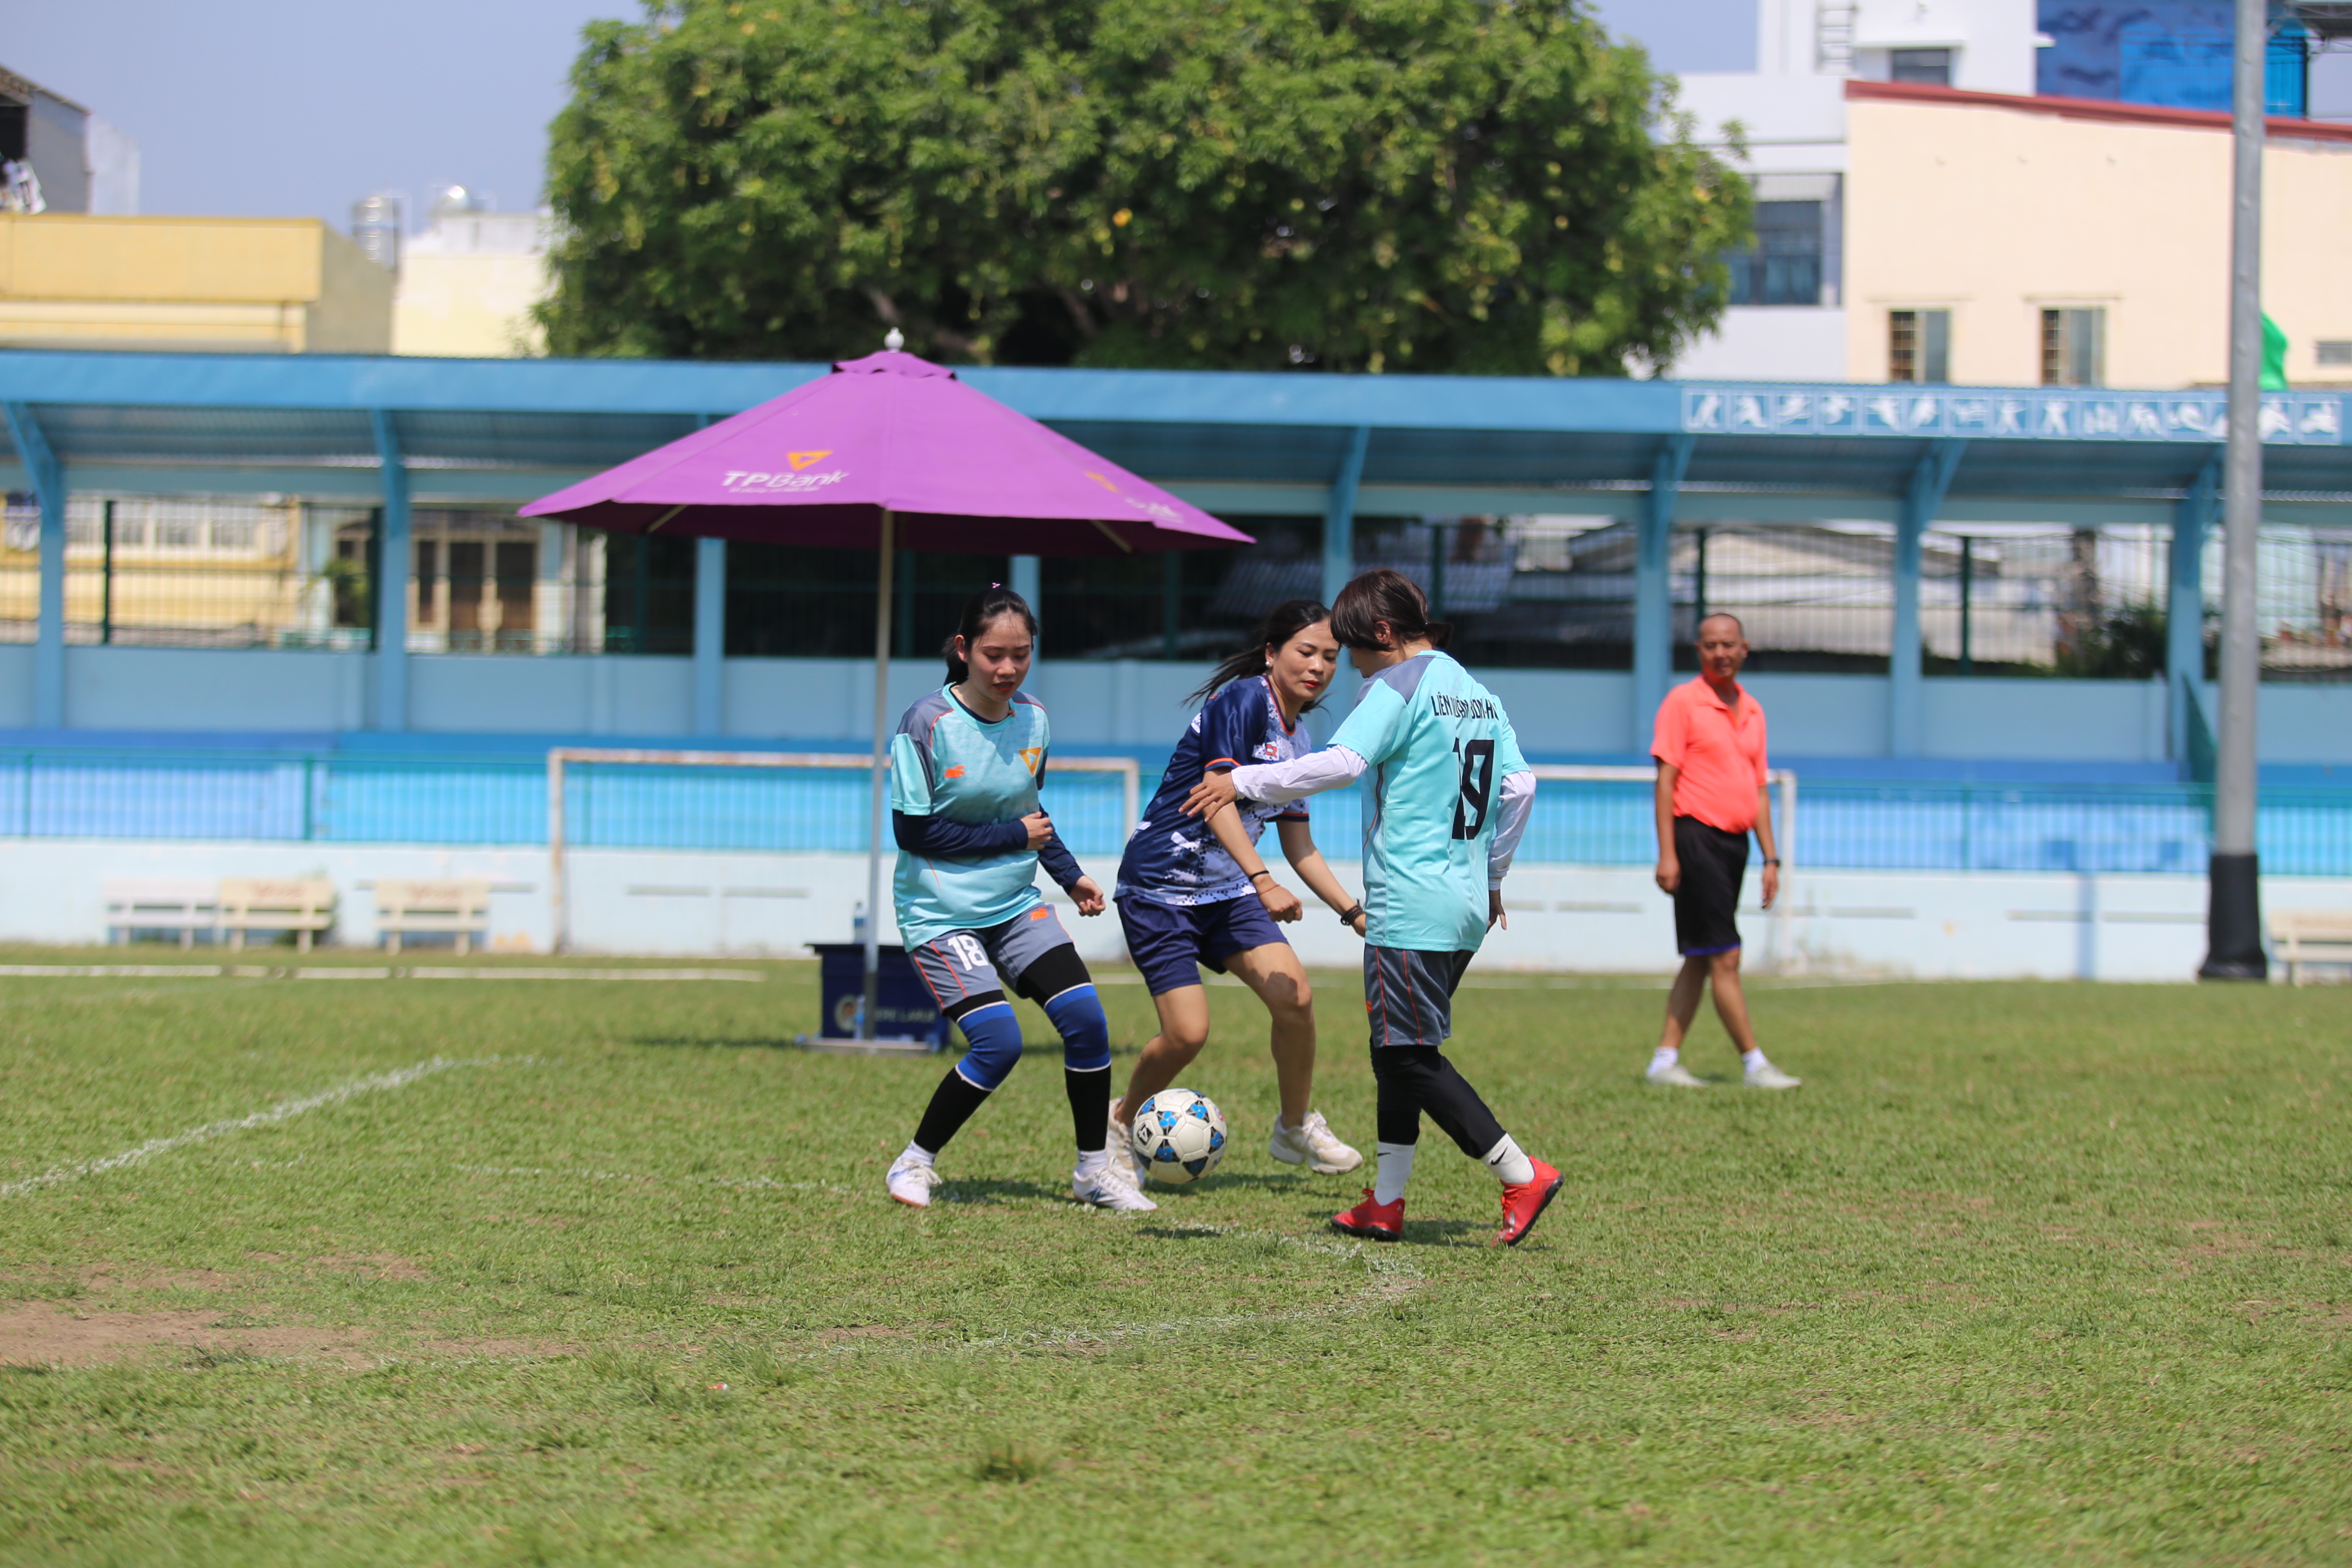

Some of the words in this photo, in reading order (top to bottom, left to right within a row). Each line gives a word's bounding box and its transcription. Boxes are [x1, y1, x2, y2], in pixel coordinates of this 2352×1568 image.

[721, 469, 850, 488] TPBank
[1431, 691, 1453, 716] LIÊN
[1451, 737, 1494, 840] 19
[948, 934, 989, 972] 18
